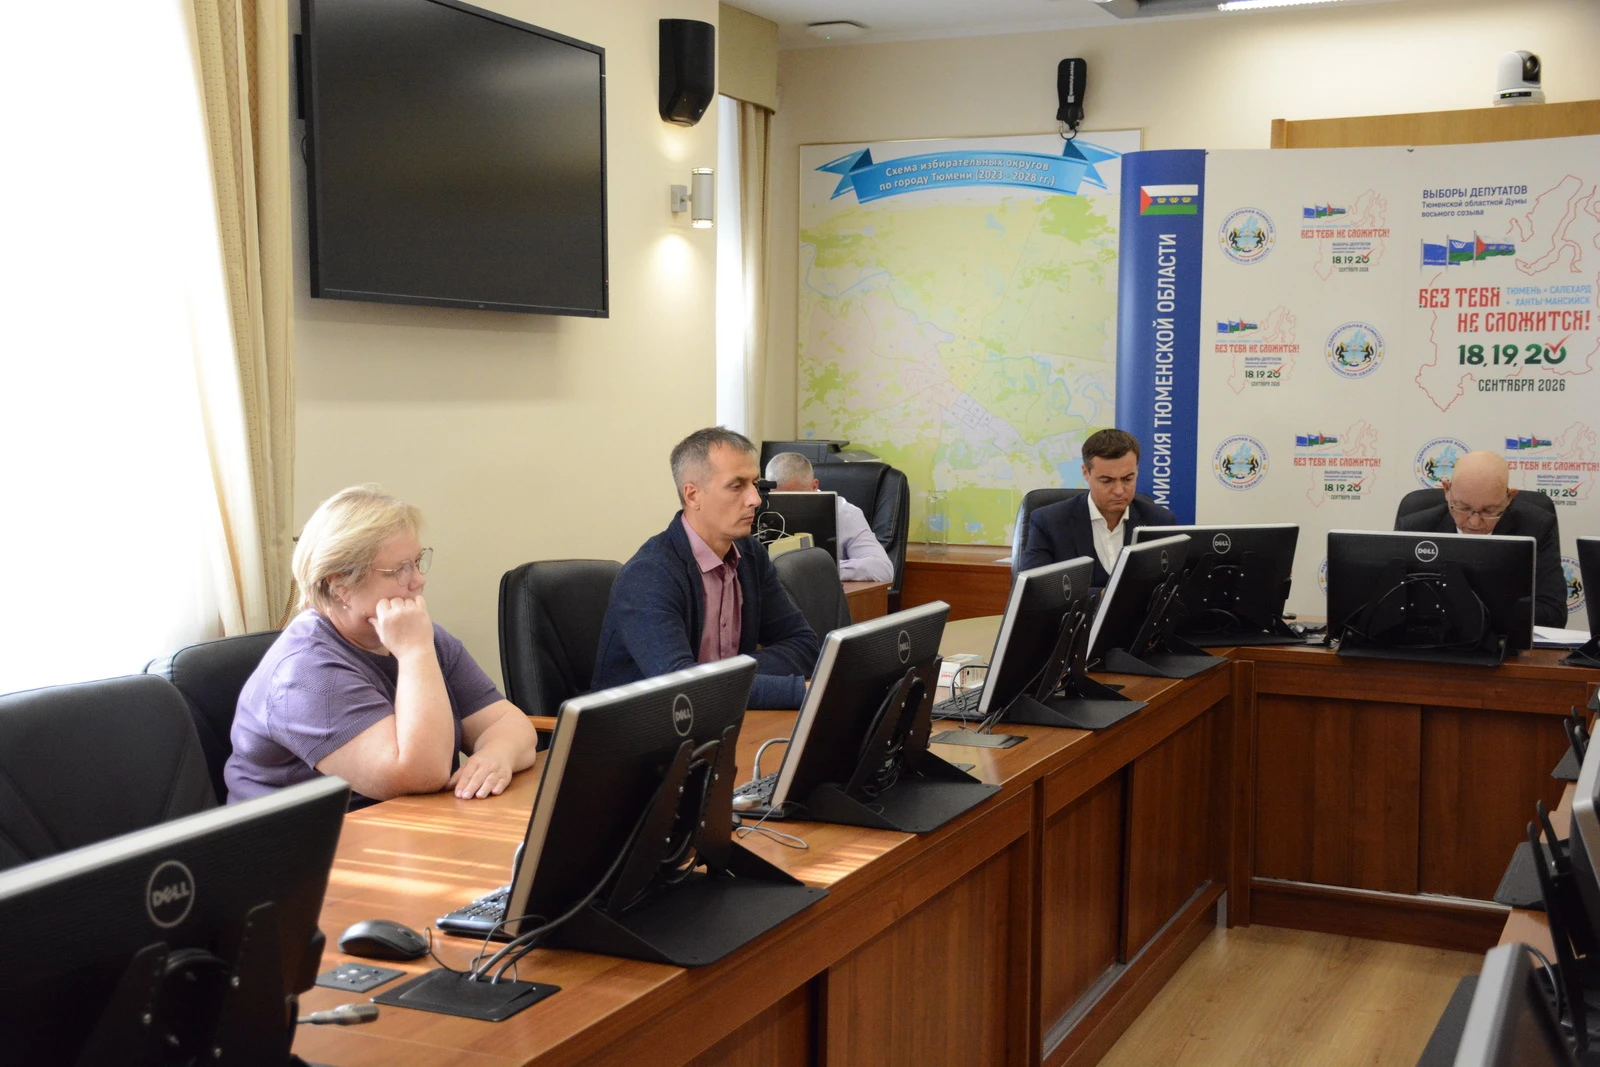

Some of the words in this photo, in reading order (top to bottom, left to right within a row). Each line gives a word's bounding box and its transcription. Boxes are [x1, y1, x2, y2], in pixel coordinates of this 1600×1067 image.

[886, 165, 918, 178] Схема
[920, 158, 1003, 170] избирательных
[1006, 158, 1049, 171] округов
[879, 183, 892, 192] по
[894, 175, 928, 188] городу
[931, 172, 972, 182] Тюмени
[976, 170, 1004, 182] (2023
[1012, 171, 1036, 182] 2028
[1040, 176, 1056, 187] гг.)
[1423, 188, 1468, 199] ВЫБОРЫ
[1470, 185, 1528, 198] ДЕПУТАТОВ
[1422, 200, 1462, 208] Тюменской
[1465, 198, 1502, 207] областной
[1504, 198, 1528, 206] Думы
[1157, 234, 1176, 312] ОБЛАСТИ
[1419, 288, 1450, 308] БЕЗ
[1456, 287, 1500, 308] ТЕБЯ
[1506, 286, 1542, 295] ТЮМЕНЬ
[1550, 285, 1592, 294] САЛЕХАРД
[1458, 312, 1479, 333] НЕ
[1485, 310, 1591, 332] СЛОЖИТСЯ!
[1524, 344, 1567, 365] 20
[1152, 318, 1174, 428] ТЮМЕНСКОЙ
[1478, 379, 1534, 392] СЕНТЯБРЯ
[1538, 379, 1566, 392] 2026
[1153, 433, 1171, 510] МИССИЯ
[1508, 461, 1517, 470] ЕЗ
[676, 708, 691, 722] DELL
[152, 882, 190, 908] DELL
